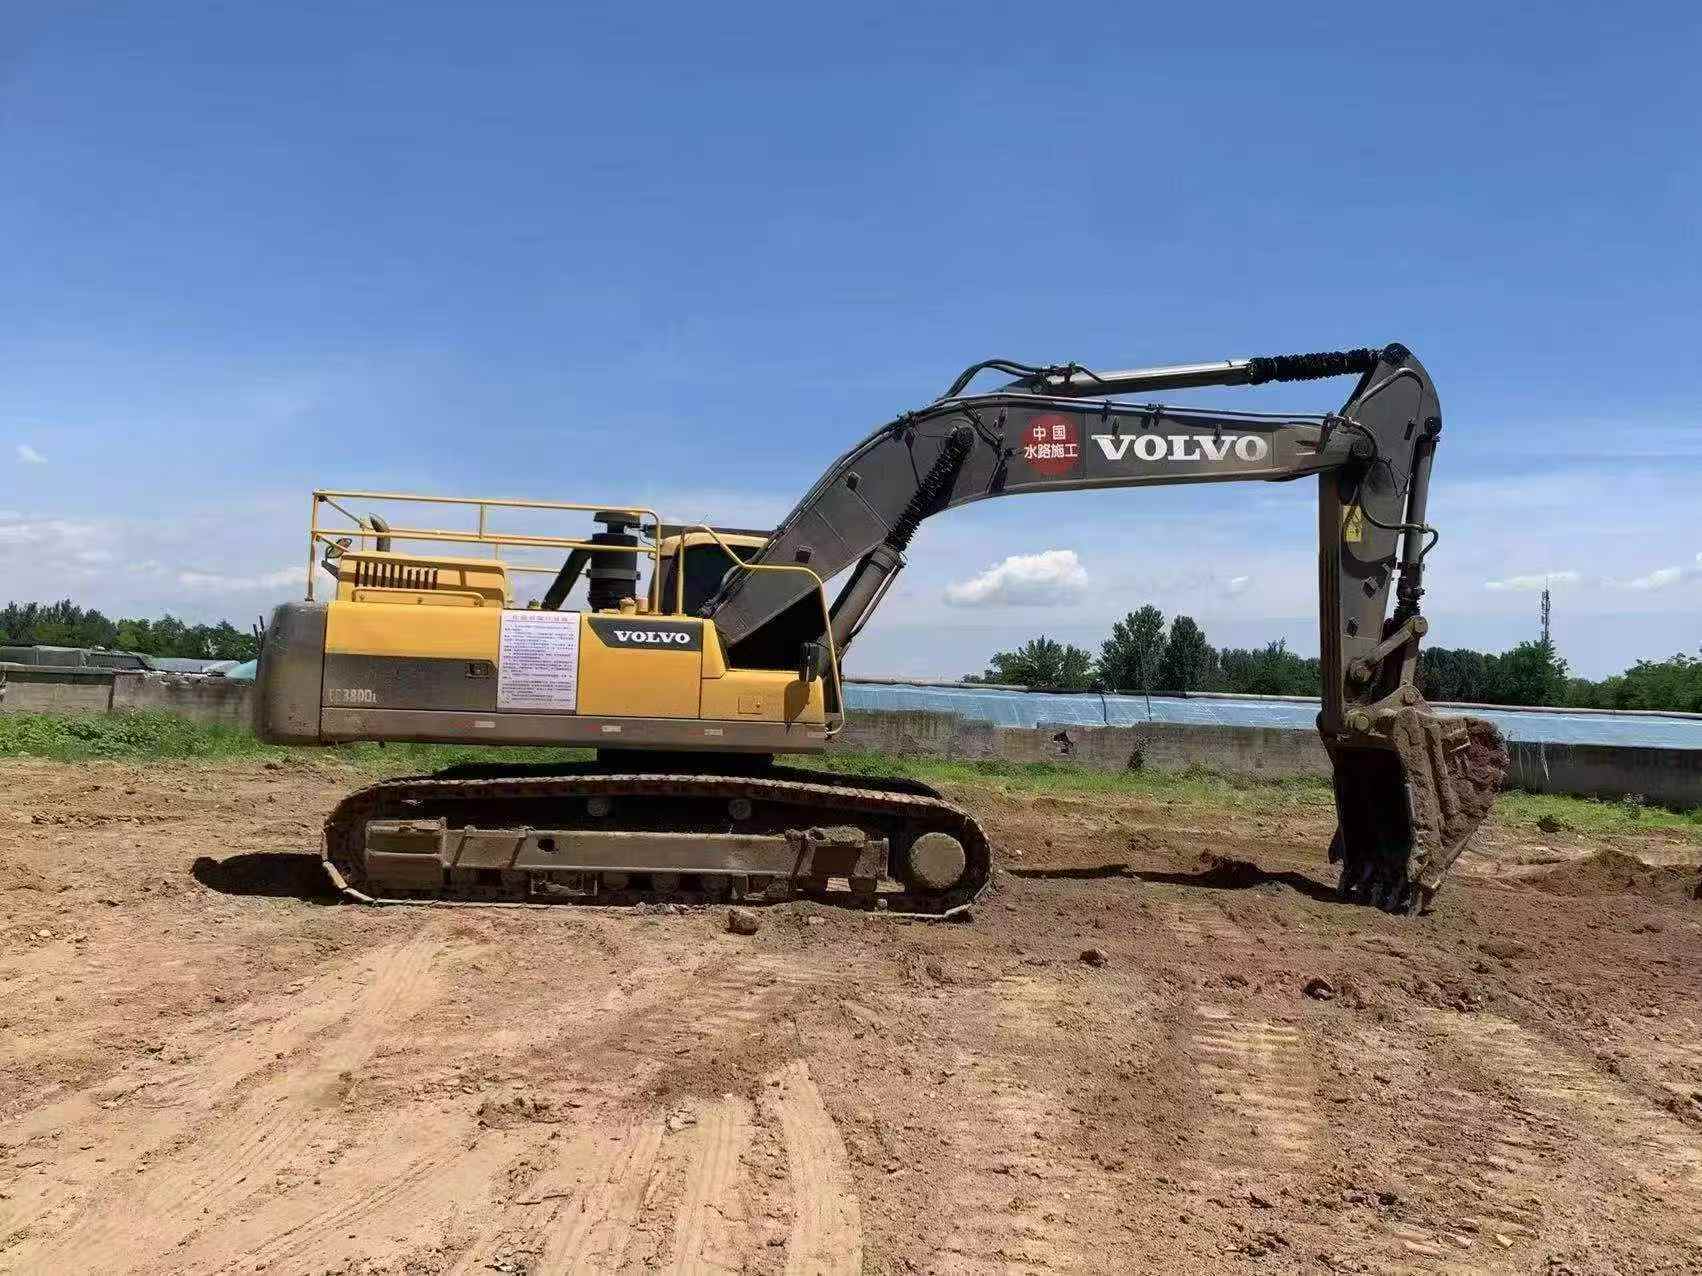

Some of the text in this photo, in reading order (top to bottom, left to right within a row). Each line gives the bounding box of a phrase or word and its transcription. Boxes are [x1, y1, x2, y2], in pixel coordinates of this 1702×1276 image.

[1033, 425, 1066, 440] 中国
[1024, 443, 1078, 459] 水路施工
[1091, 434, 1268, 461] VOLVO
[613, 630, 691, 644] VOLVO
